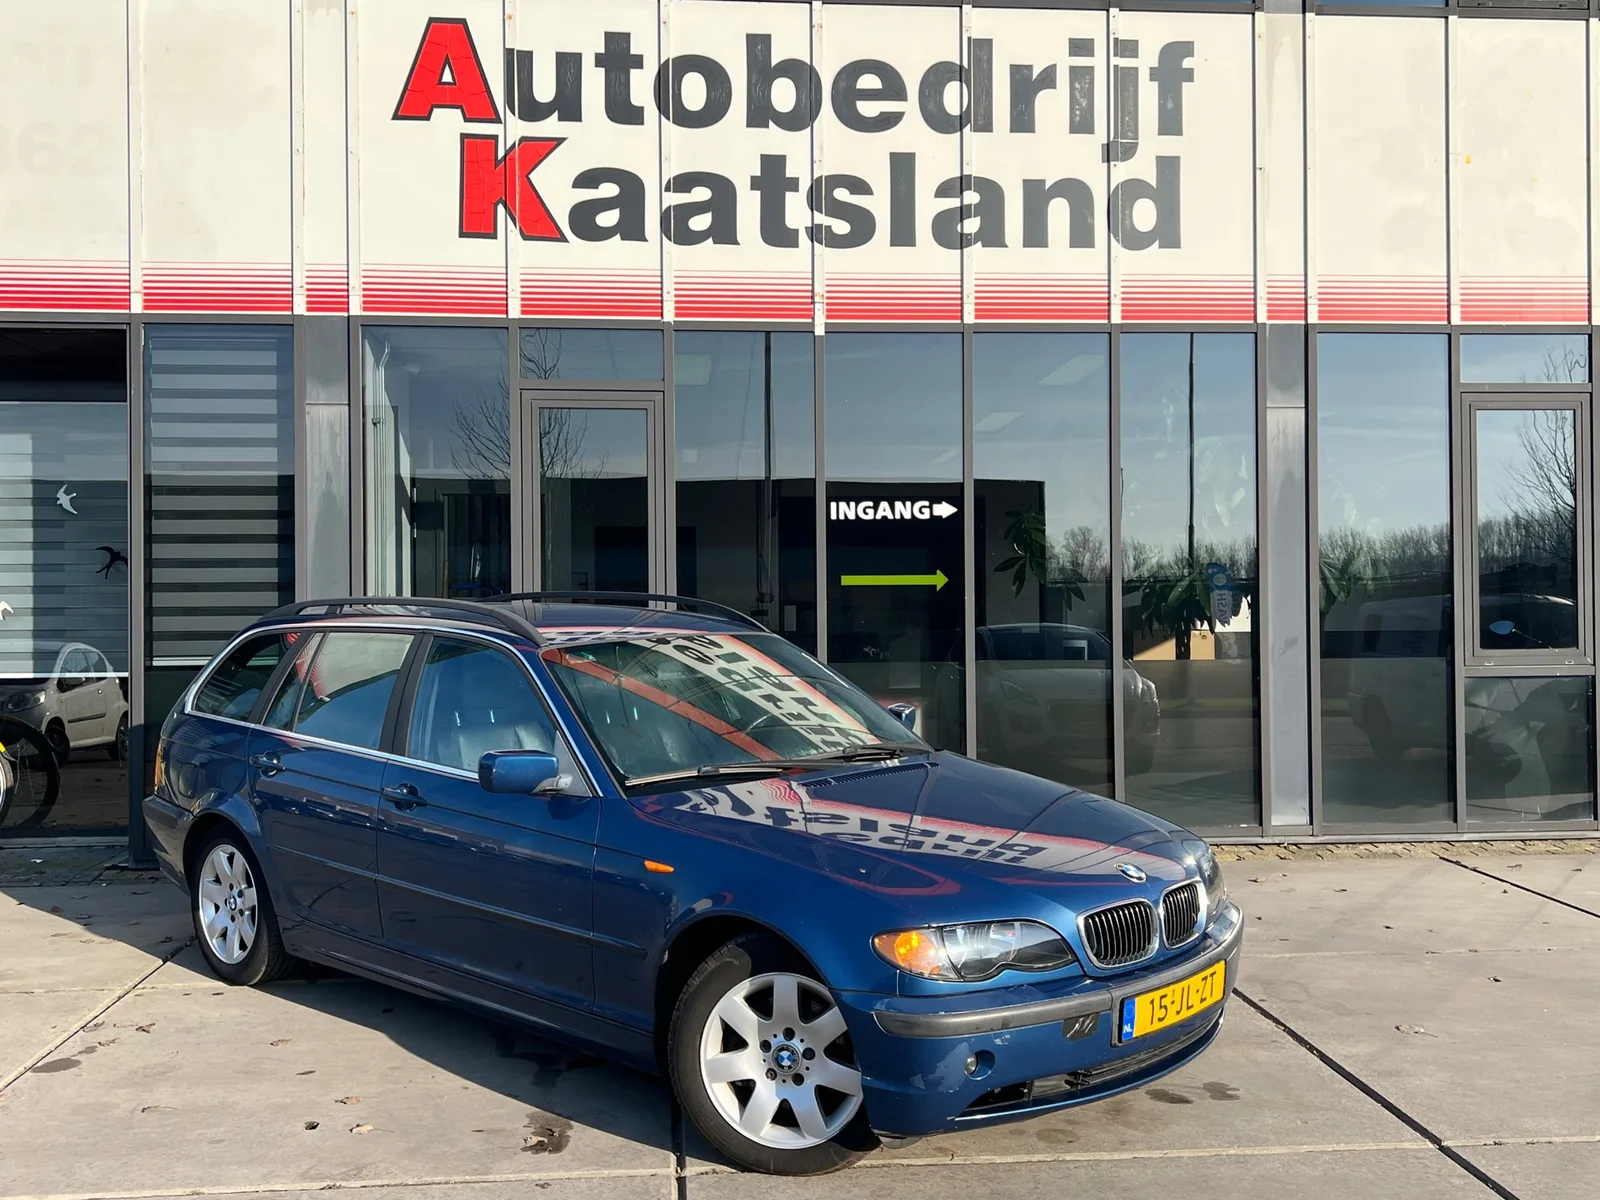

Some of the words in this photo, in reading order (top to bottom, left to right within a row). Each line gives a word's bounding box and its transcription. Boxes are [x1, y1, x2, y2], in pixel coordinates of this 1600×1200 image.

[391, 17, 1195, 163] Autobedrijf
[459, 133, 1181, 251] Kaatsland
[830, 500, 931, 520] INGANG
[1149, 970, 1217, 1026] 15-JL-ZT
[1123, 1023, 1133, 1034] NL
